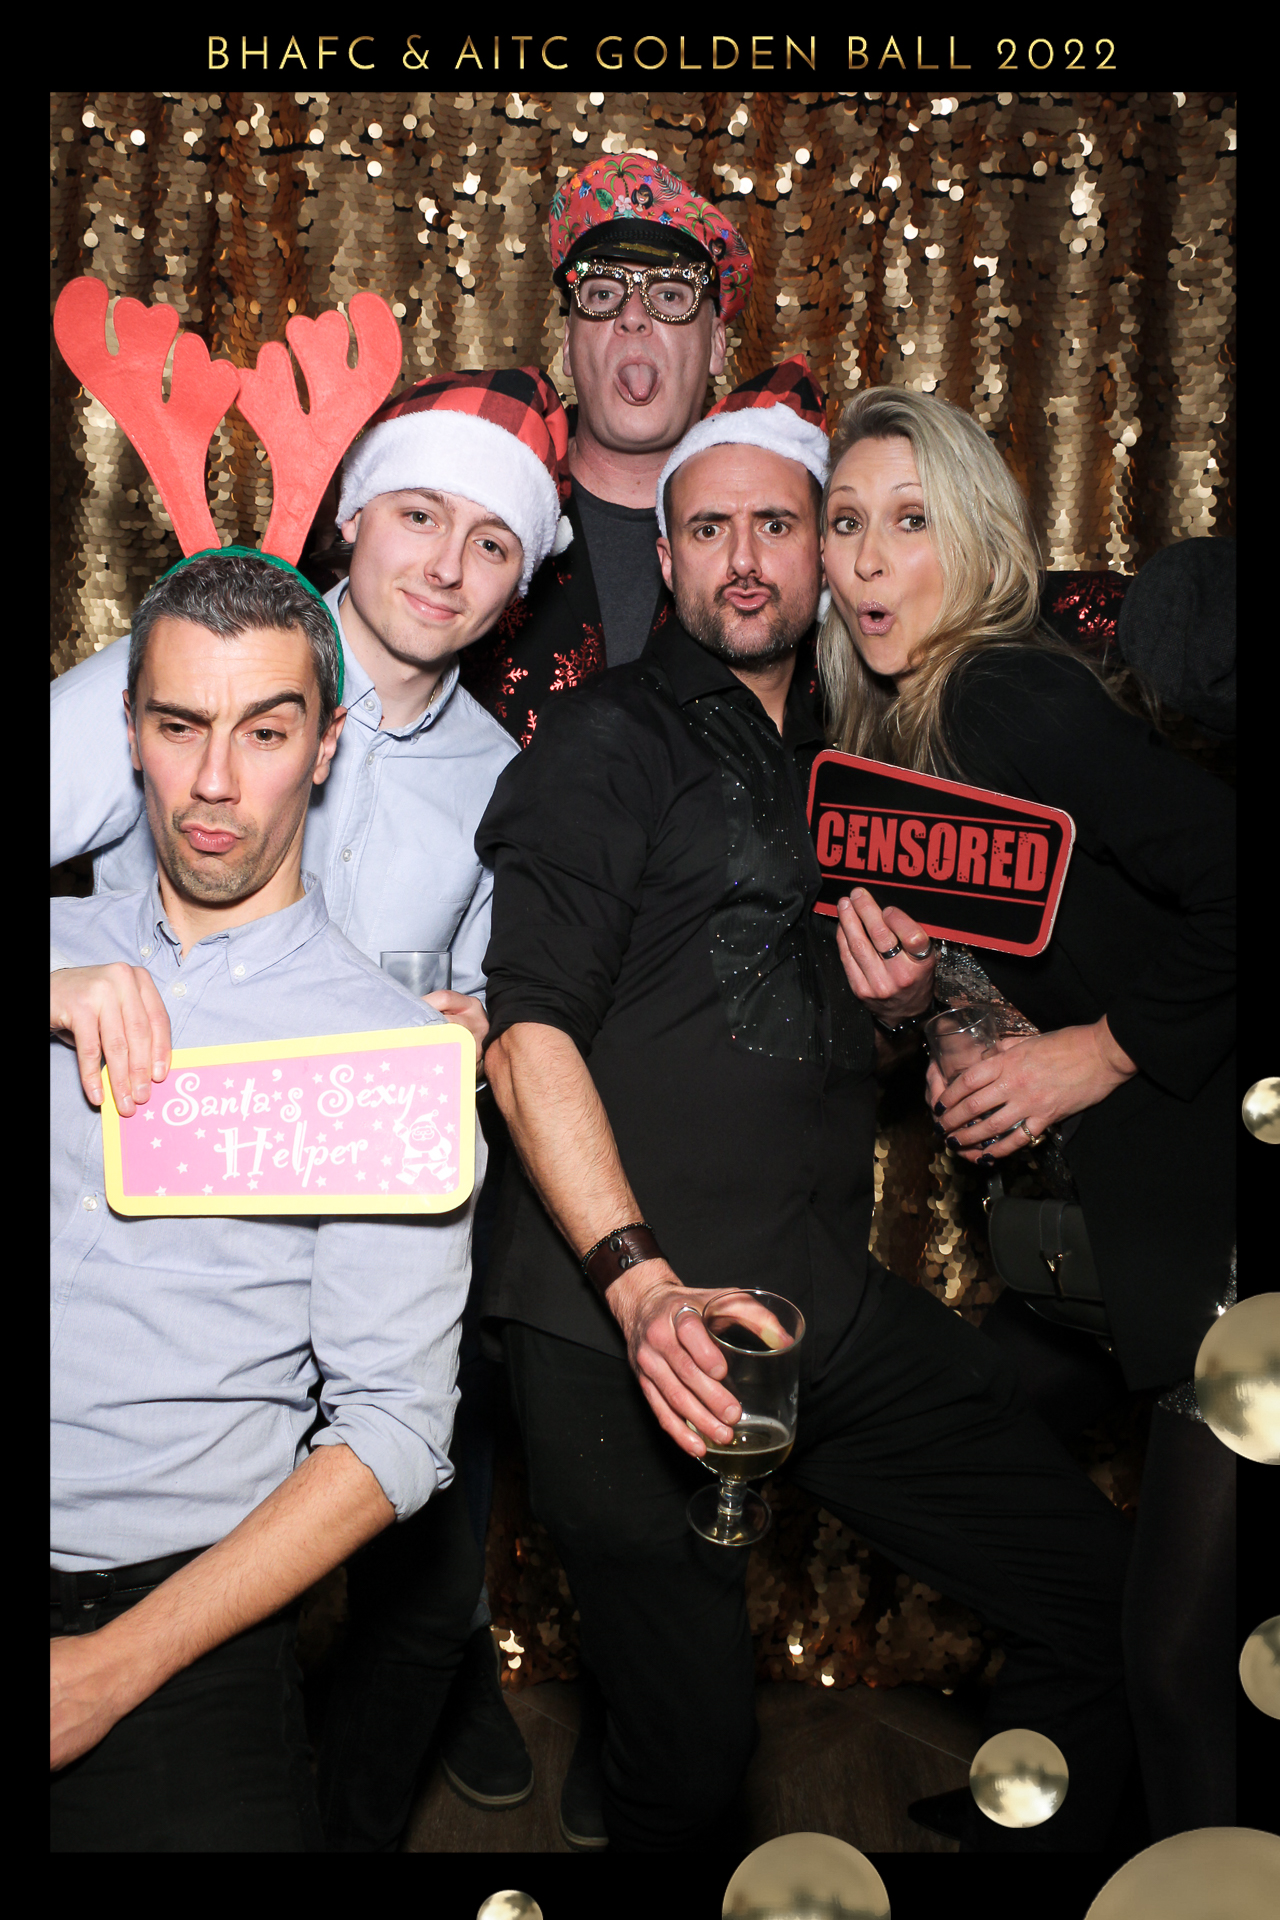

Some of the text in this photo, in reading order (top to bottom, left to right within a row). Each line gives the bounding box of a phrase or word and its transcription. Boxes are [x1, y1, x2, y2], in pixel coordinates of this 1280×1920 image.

[816, 810, 1049, 892] CENSORED
[161, 1064, 418, 1126] Santa's Sexy
[213, 1120, 369, 1188] Helper
